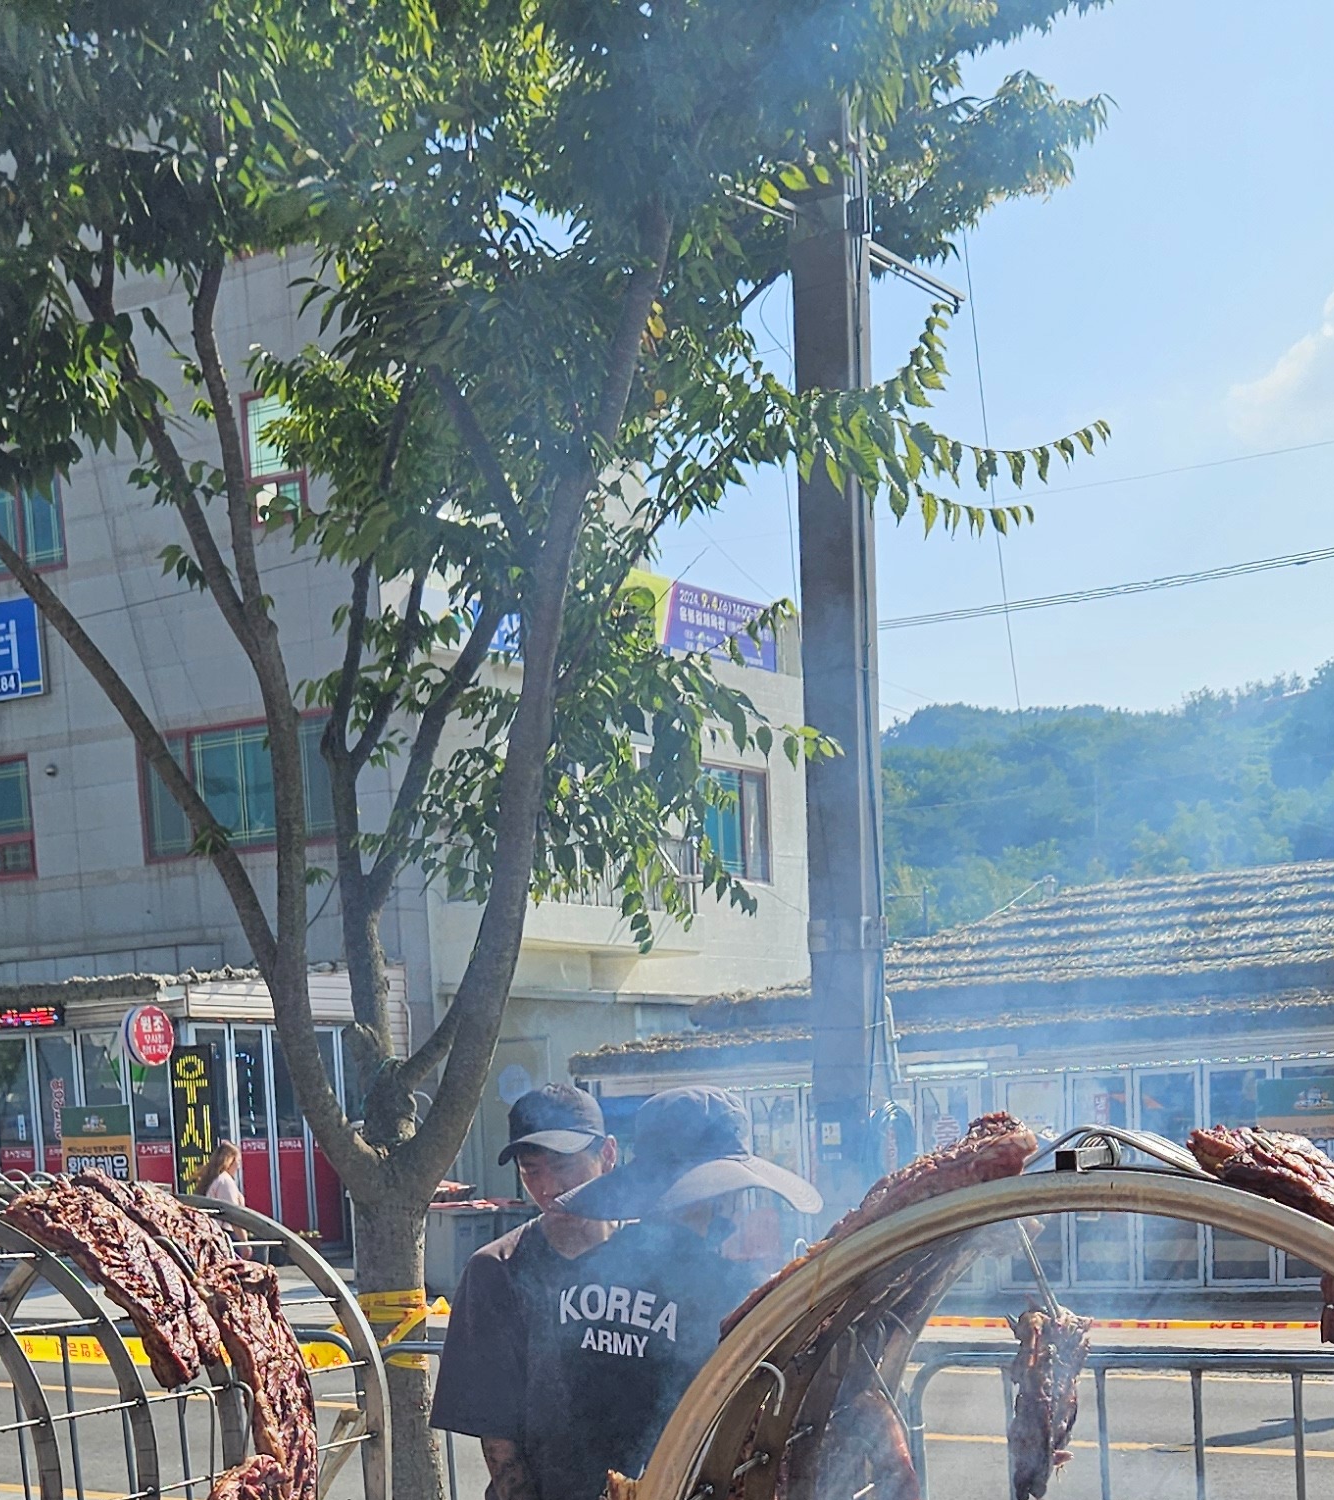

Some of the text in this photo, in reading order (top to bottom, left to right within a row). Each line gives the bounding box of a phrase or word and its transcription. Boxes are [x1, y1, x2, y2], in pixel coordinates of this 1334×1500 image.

[140, 1015, 165, 1032] 원조
[559, 1283, 678, 1342] KOREA
[580, 1326, 650, 1358] ARMY
